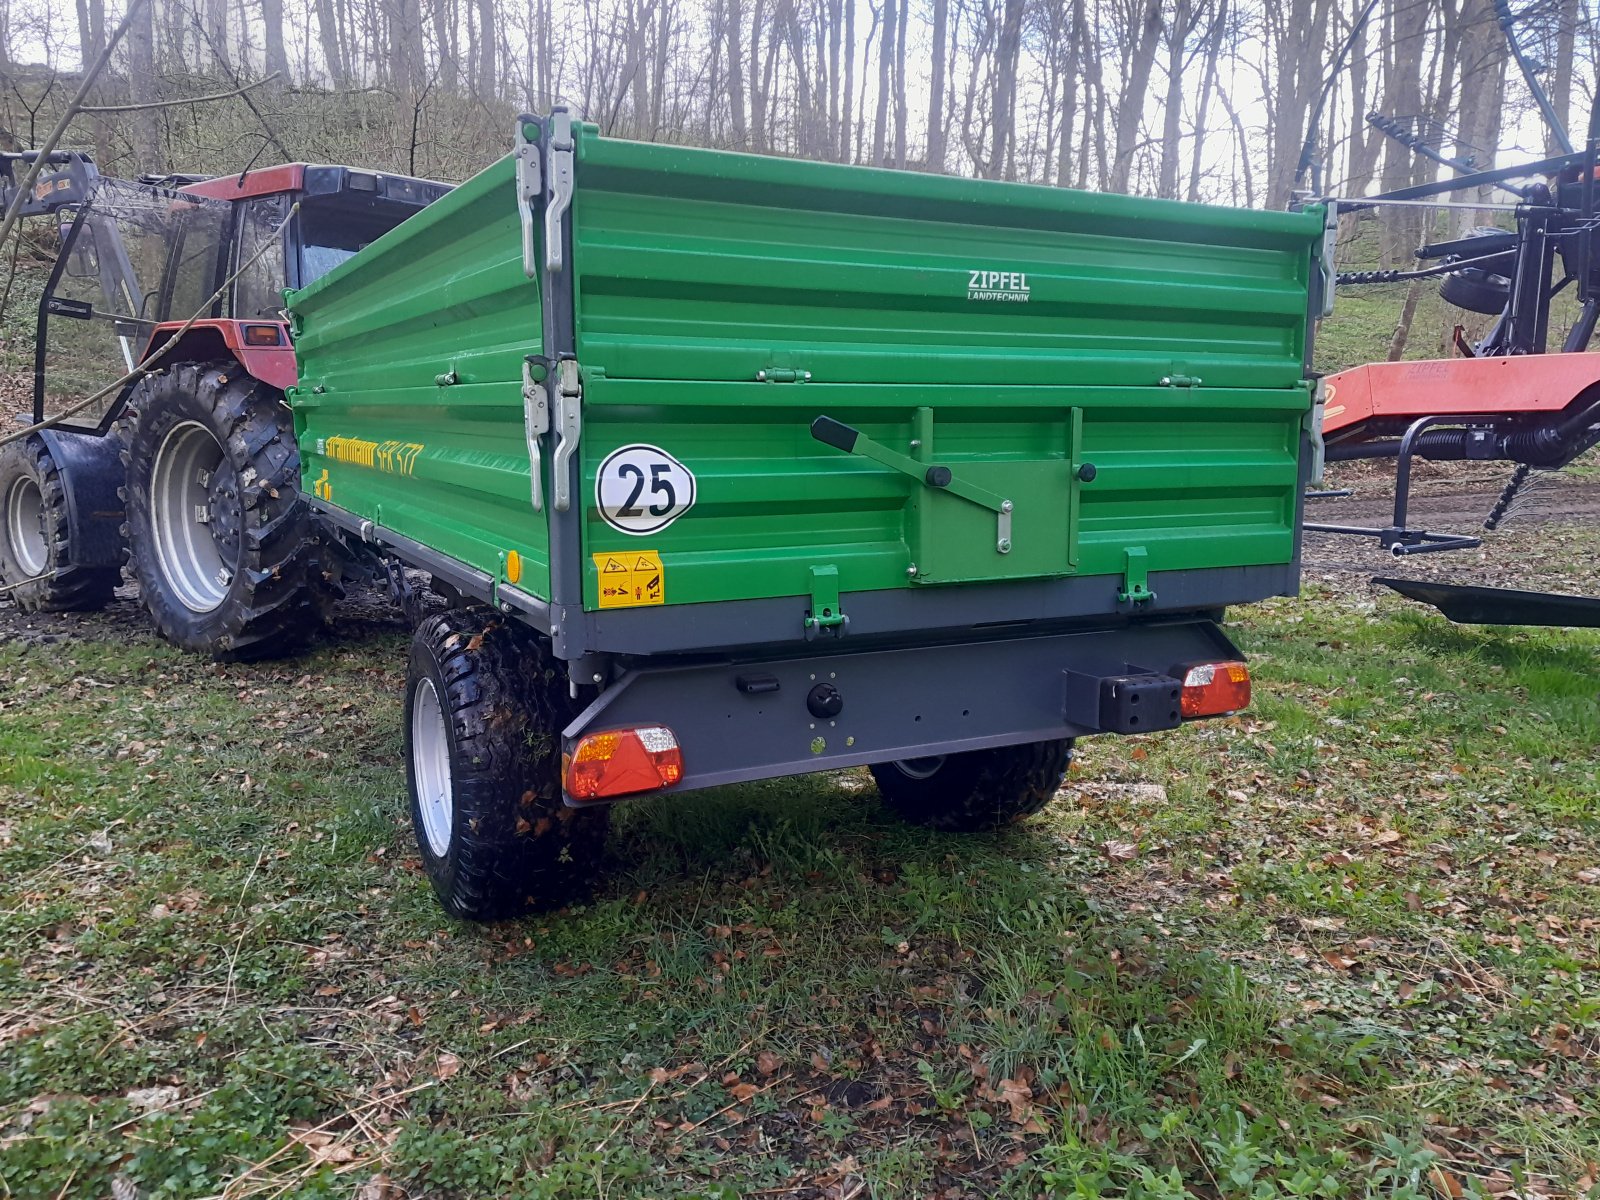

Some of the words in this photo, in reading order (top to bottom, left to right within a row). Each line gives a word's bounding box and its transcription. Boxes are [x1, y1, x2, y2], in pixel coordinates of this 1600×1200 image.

[968, 270, 1031, 291] ZIPFEL
[967, 291, 1030, 303] LANDTECHNIK
[615, 463, 676, 518] 25
